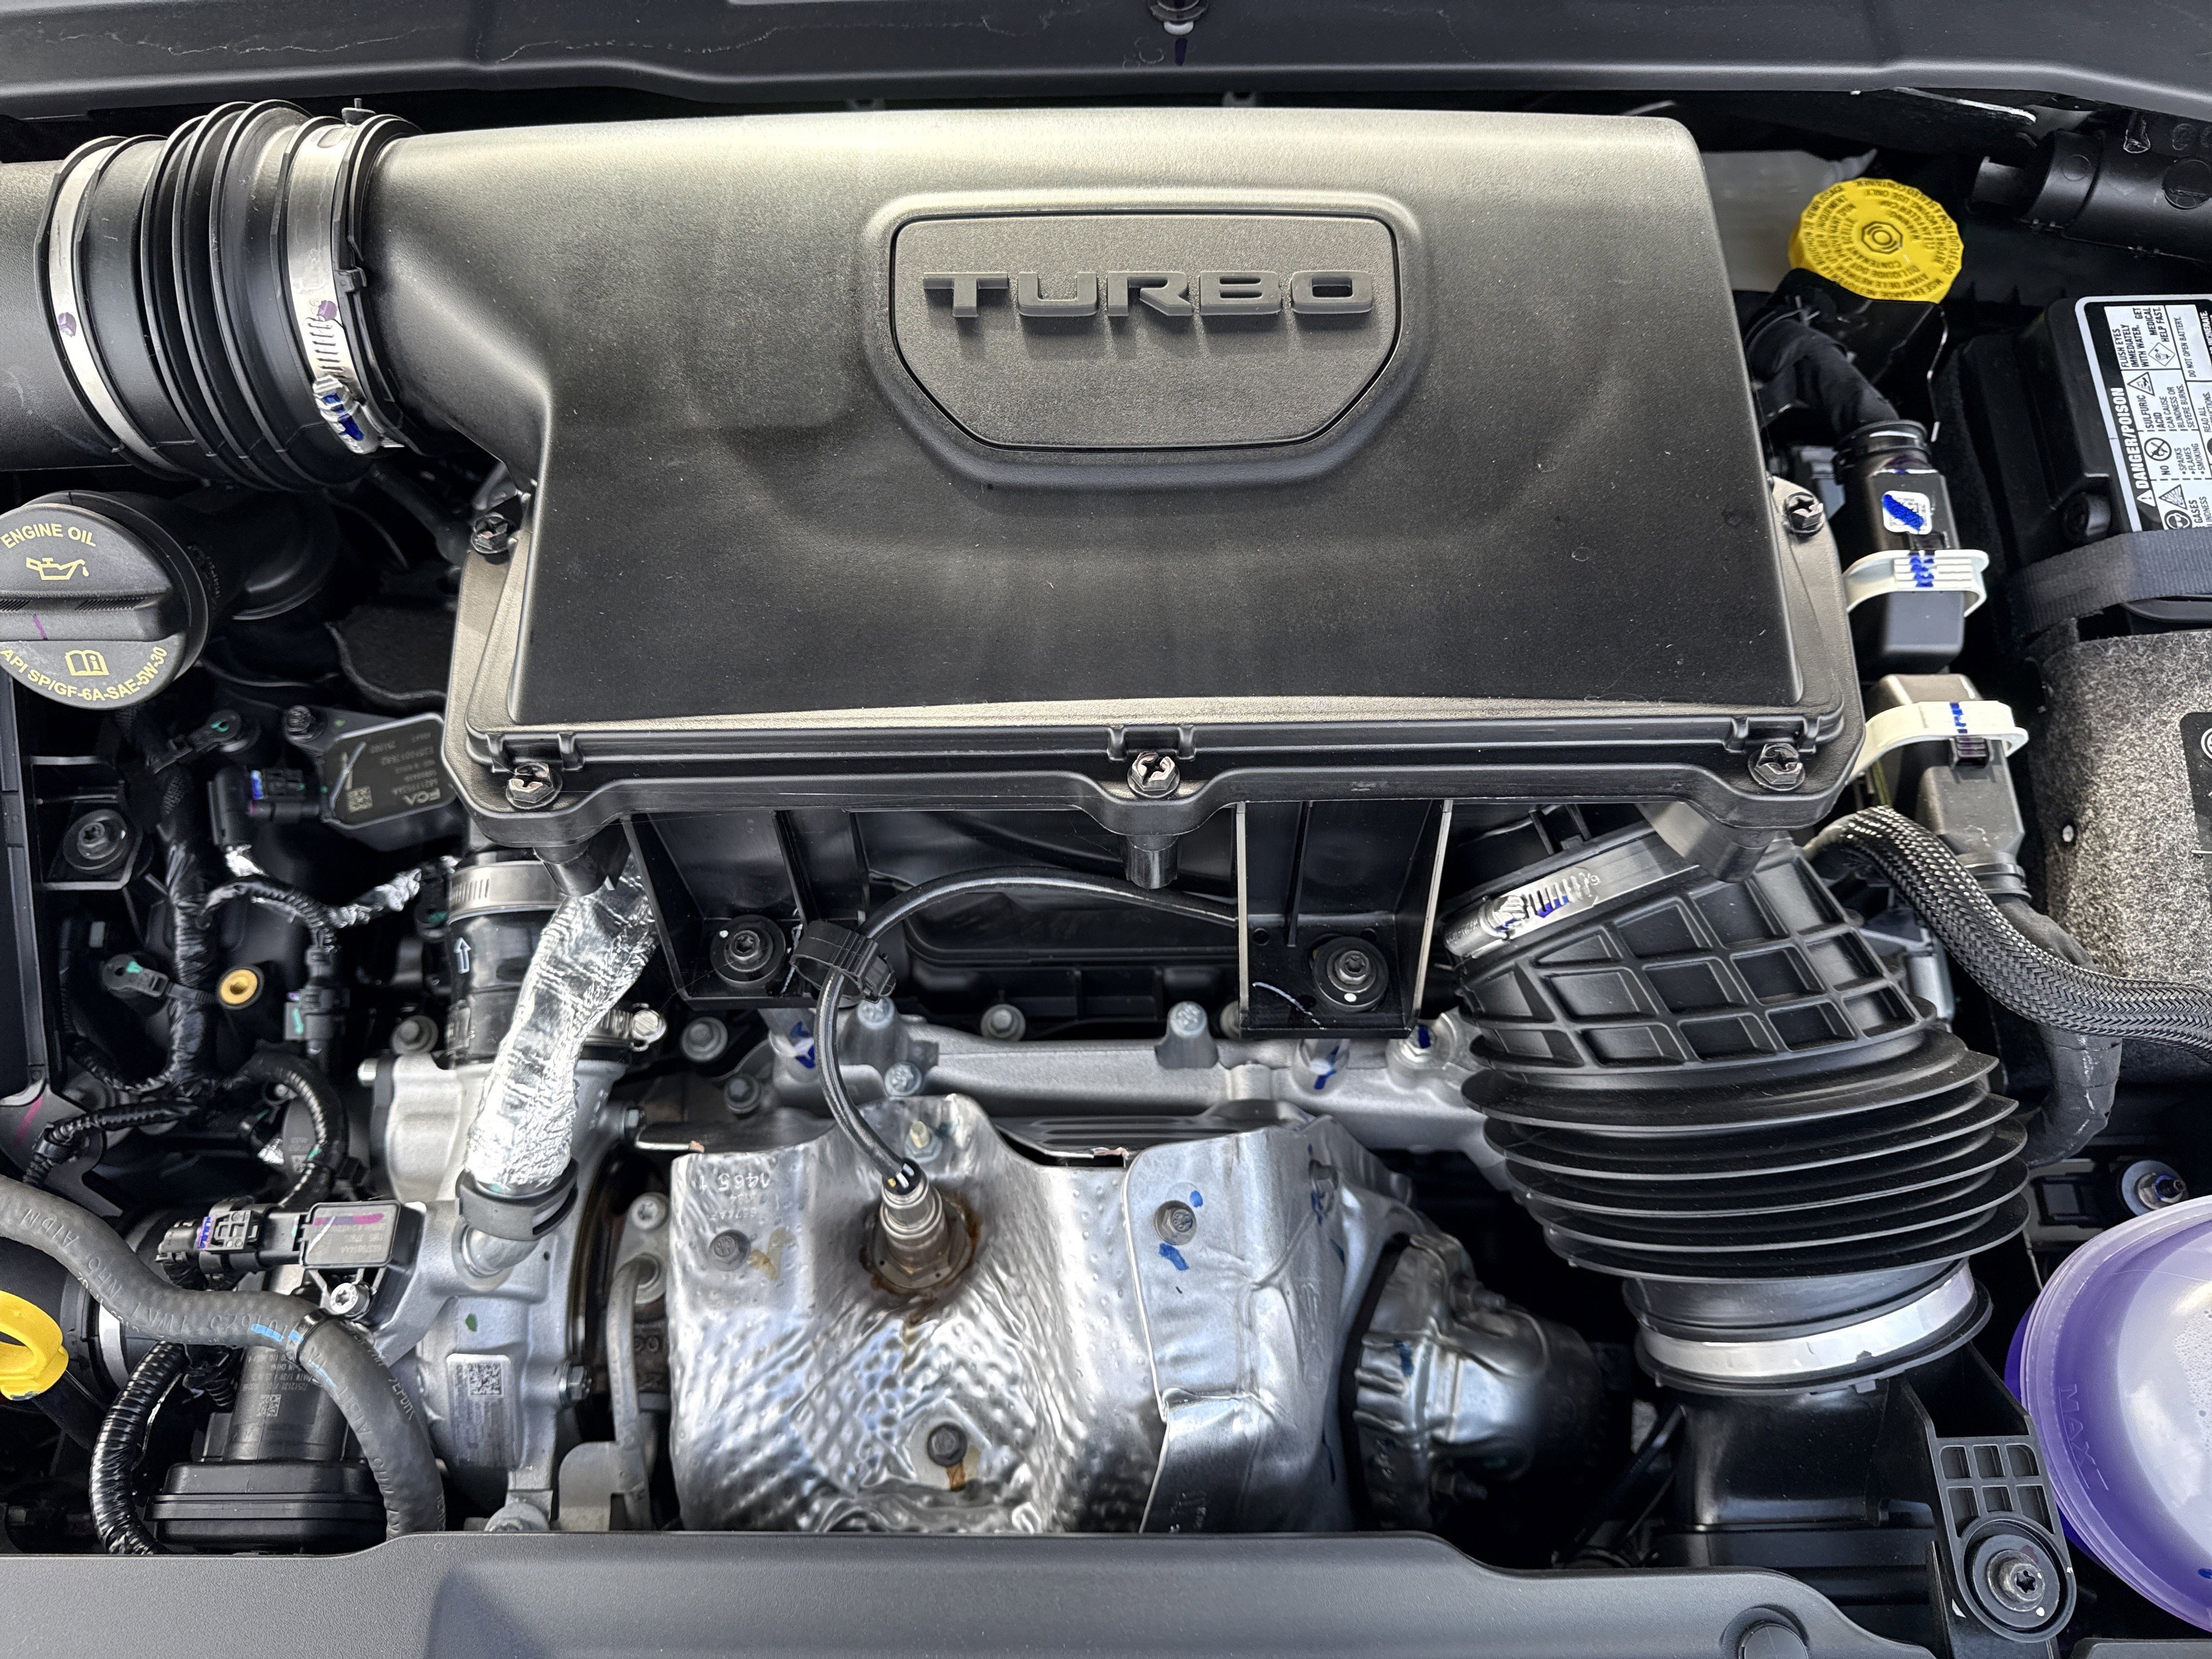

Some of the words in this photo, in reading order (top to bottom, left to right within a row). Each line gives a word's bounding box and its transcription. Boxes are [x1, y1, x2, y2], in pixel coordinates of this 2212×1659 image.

[923, 271, 1373, 318] TURBO
[2132, 307, 2143, 319] GET
[2143, 307, 2158, 336] MEDICAL
[2113, 329, 2124, 345] EYES
[2131, 325, 2145, 349] WATER.
[2158, 326, 2170, 342] HELP
[2120, 324, 2140, 368] IMMEDIATELY
[2181, 342, 2191, 357] OPEN
[2117, 347, 2130, 368] FLUSH
[2138, 351, 2149, 367] WITH
[2184, 358, 2194, 369] NOT
[2167, 387, 2176, 395] OR
[2176, 384, 2188, 405] BURNS.
[2136, 395, 2154, 428] SULFURIC
[2159, 396, 2172, 415] CAUSE
[2169, 396, 2185, 428] BLINDNESS
[2197, 407, 2208, 416] ALL
[2153, 412, 2166, 428] ACID
[2165, 416, 2175, 428] CAN
[2182, 407, 2195, 428] SEVERE
[2200, 417, 2211, 432] READ
[2110, 387, 2150, 489] DANGER/POISON
[2160, 465, 2171, 475] NO
[2188, 500, 2203, 523] GASES
[0, 523, 64, 549] ENGINE
[67, 526, 96, 547] OIL
[0, 649, 29, 673] API
[2061, 1384, 2096, 1466] MAX
